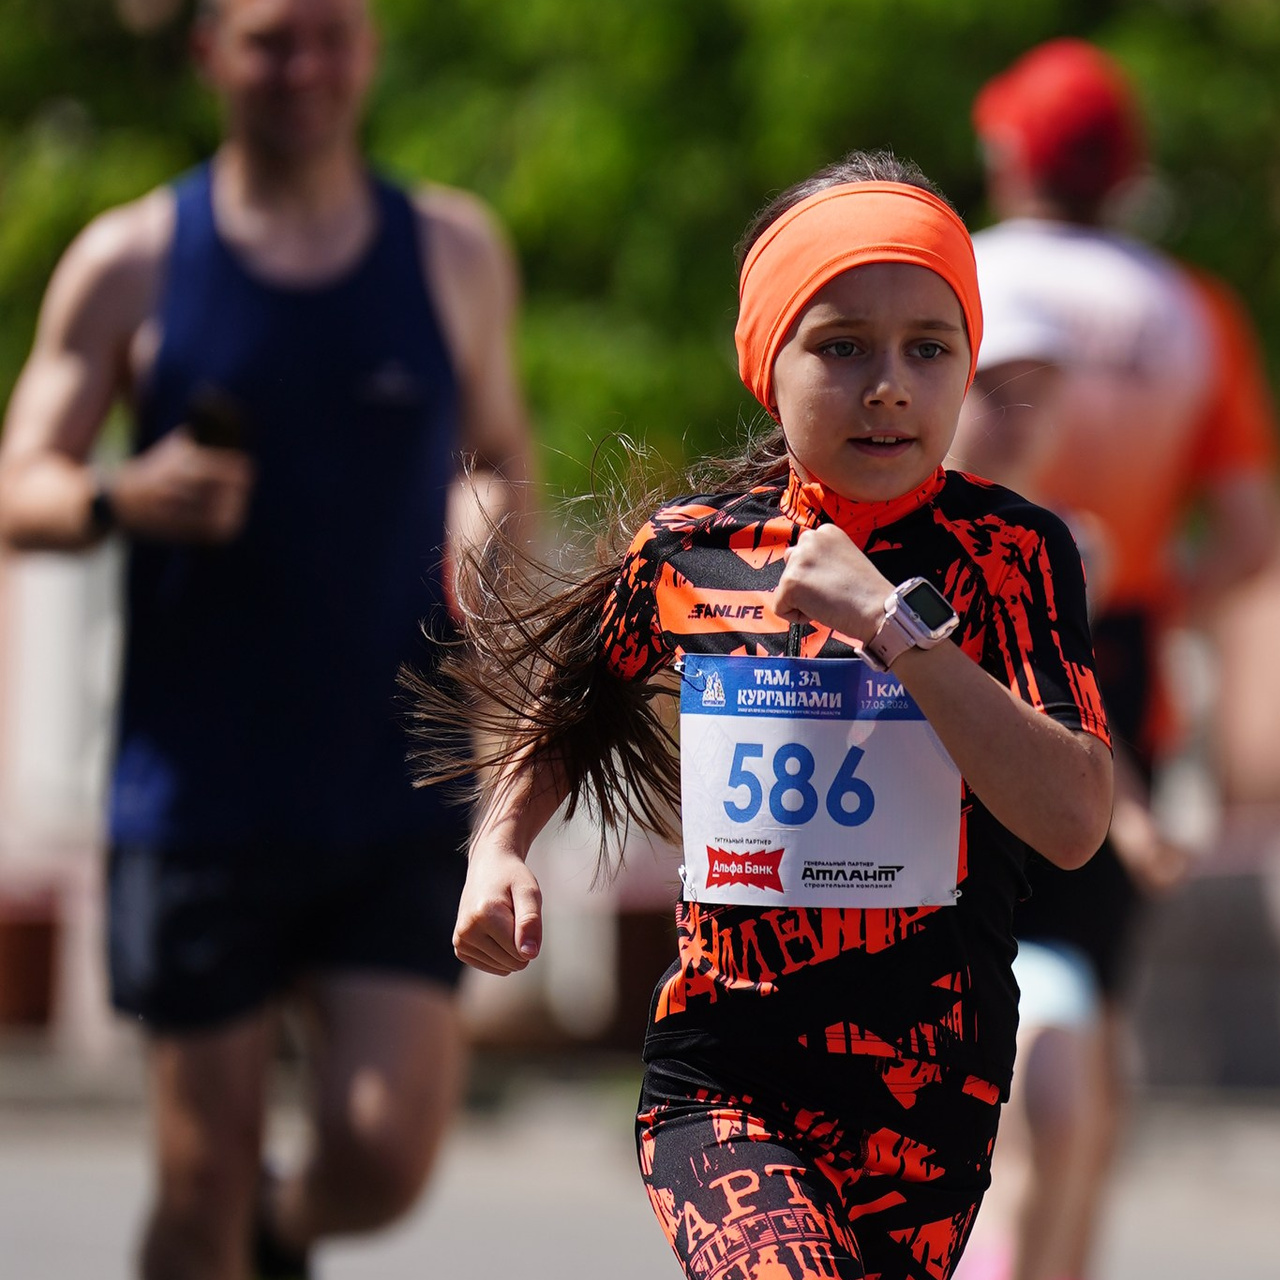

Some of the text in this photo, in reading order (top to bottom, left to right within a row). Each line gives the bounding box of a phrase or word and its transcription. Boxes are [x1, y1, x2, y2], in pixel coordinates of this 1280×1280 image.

[690, 603, 764, 619] FANLIFE
[754, 669, 822, 688] ТАМ, ЗА
[737, 689, 843, 709] КУРГАНАМИ
[861, 699, 909, 711] 17.05.2026
[723, 742, 875, 827] 586
[745, 838, 772, 846] ПАРТНЕР
[712, 860, 773, 877] Альфа Банк
